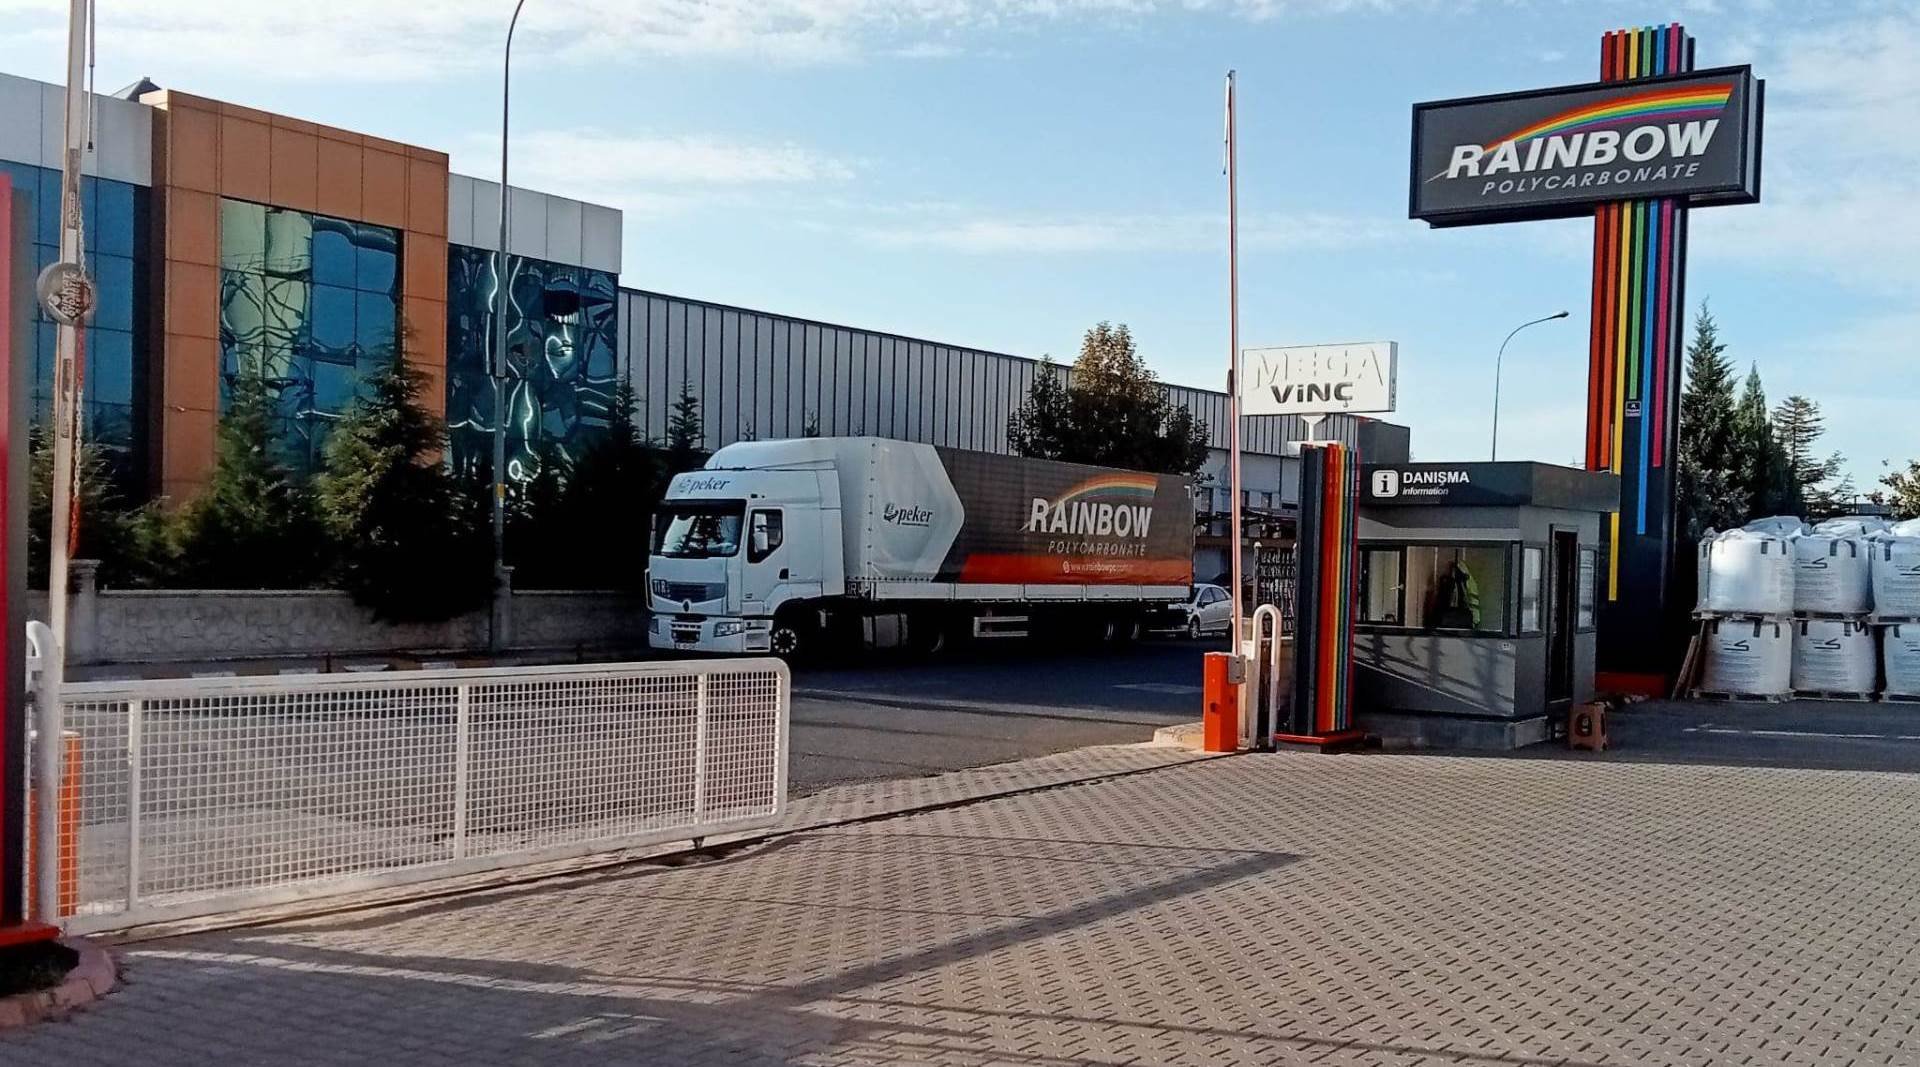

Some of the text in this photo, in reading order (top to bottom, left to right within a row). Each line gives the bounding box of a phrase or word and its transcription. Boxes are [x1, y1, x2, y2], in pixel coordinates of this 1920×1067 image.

[1446, 119, 1720, 179] RAINBOW
[1481, 162, 1700, 196] POLYCARBONATE
[688, 476, 731, 495] peker
[1402, 471, 1470, 486] DANIŞMA
[1402, 486, 1449, 496] information
[896, 505, 933, 526] peker
[1029, 497, 1153, 538] RAINBOW
[1047, 540, 1147, 557] POLYCARBONATE
